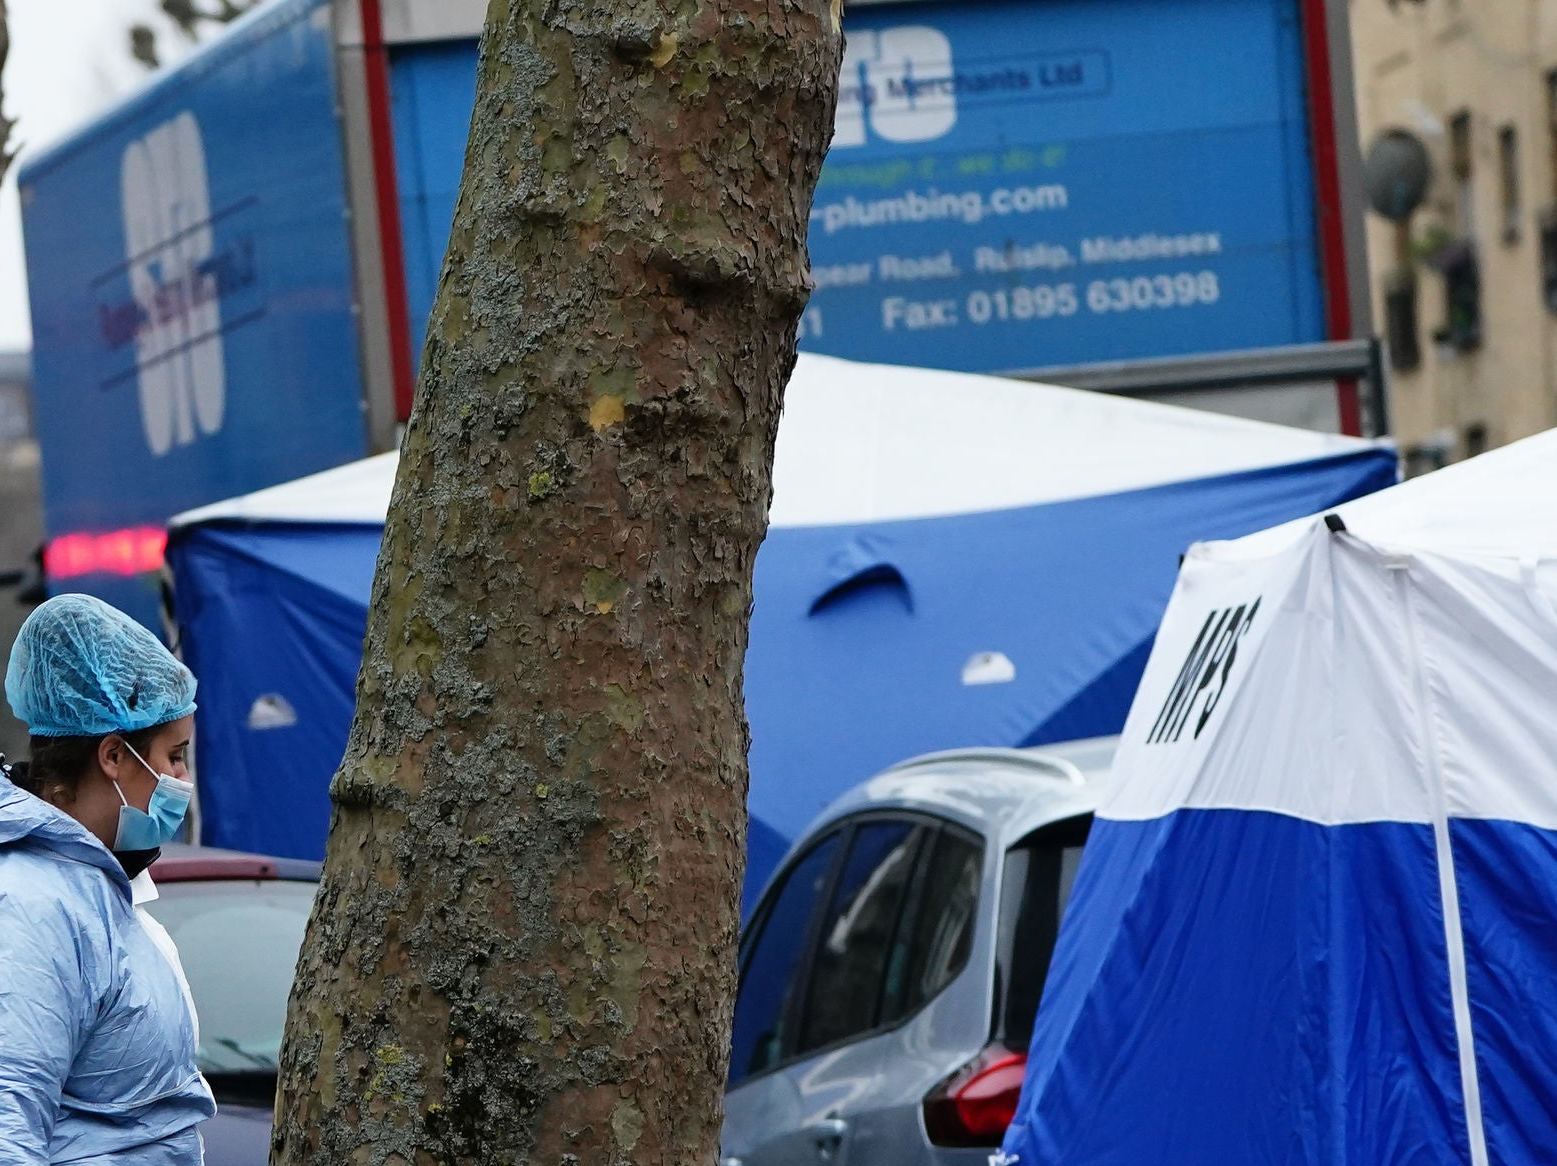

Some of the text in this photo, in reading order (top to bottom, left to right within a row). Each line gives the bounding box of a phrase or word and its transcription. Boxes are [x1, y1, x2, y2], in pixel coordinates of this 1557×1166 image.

[1039, 62, 1084, 87] Ltd
[810, 184, 1069, 234] -plumbing.com
[1080, 232, 1222, 263] Middlesex
[881, 270, 1220, 331] Fax: 01895 630398
[1146, 594, 1262, 744] MPS
